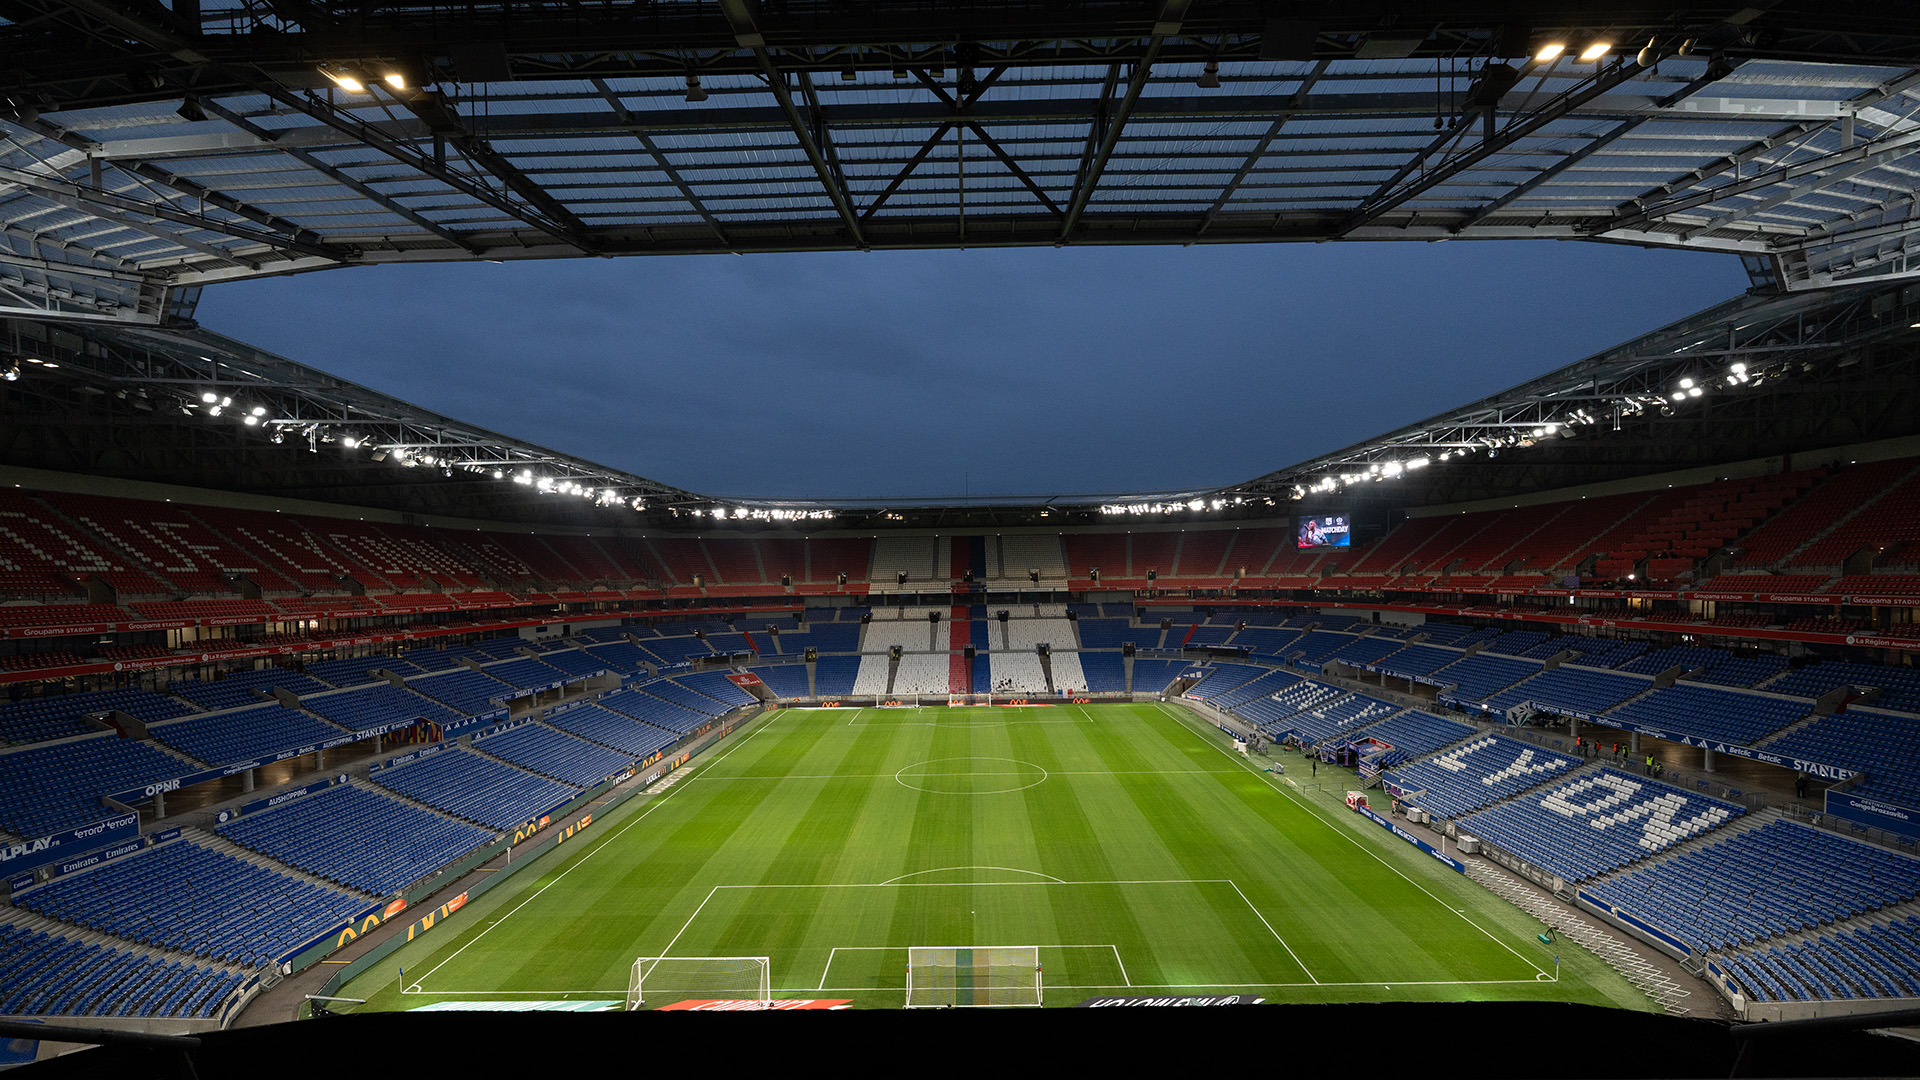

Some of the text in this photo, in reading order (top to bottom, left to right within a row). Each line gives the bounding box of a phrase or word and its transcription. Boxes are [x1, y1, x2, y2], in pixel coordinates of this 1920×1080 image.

[1694, 592, 1720, 600] Groupama
[1770, 594, 1802, 602] Groupama
[1853, 596, 1892, 604] Groupama
[24, 627, 64, 636] Groupama
[128, 622, 160, 630] Groupama
[1864, 638, 1890, 646] Région
[132, 660, 152, 669] Région
[356, 725, 388, 740] STANLEY
[1728, 746, 1752, 758] Betclic
[1758, 752, 1782, 764] Betclic
[392, 752, 415, 766] Emirates
[1794, 760, 1859, 780] STANLEY
[1861, 800, 1896, 812] DESTINATION
[106, 842, 138, 860] Emirates
[63, 856, 100, 873] Emirates
[13, 878, 33, 890] Emirates
